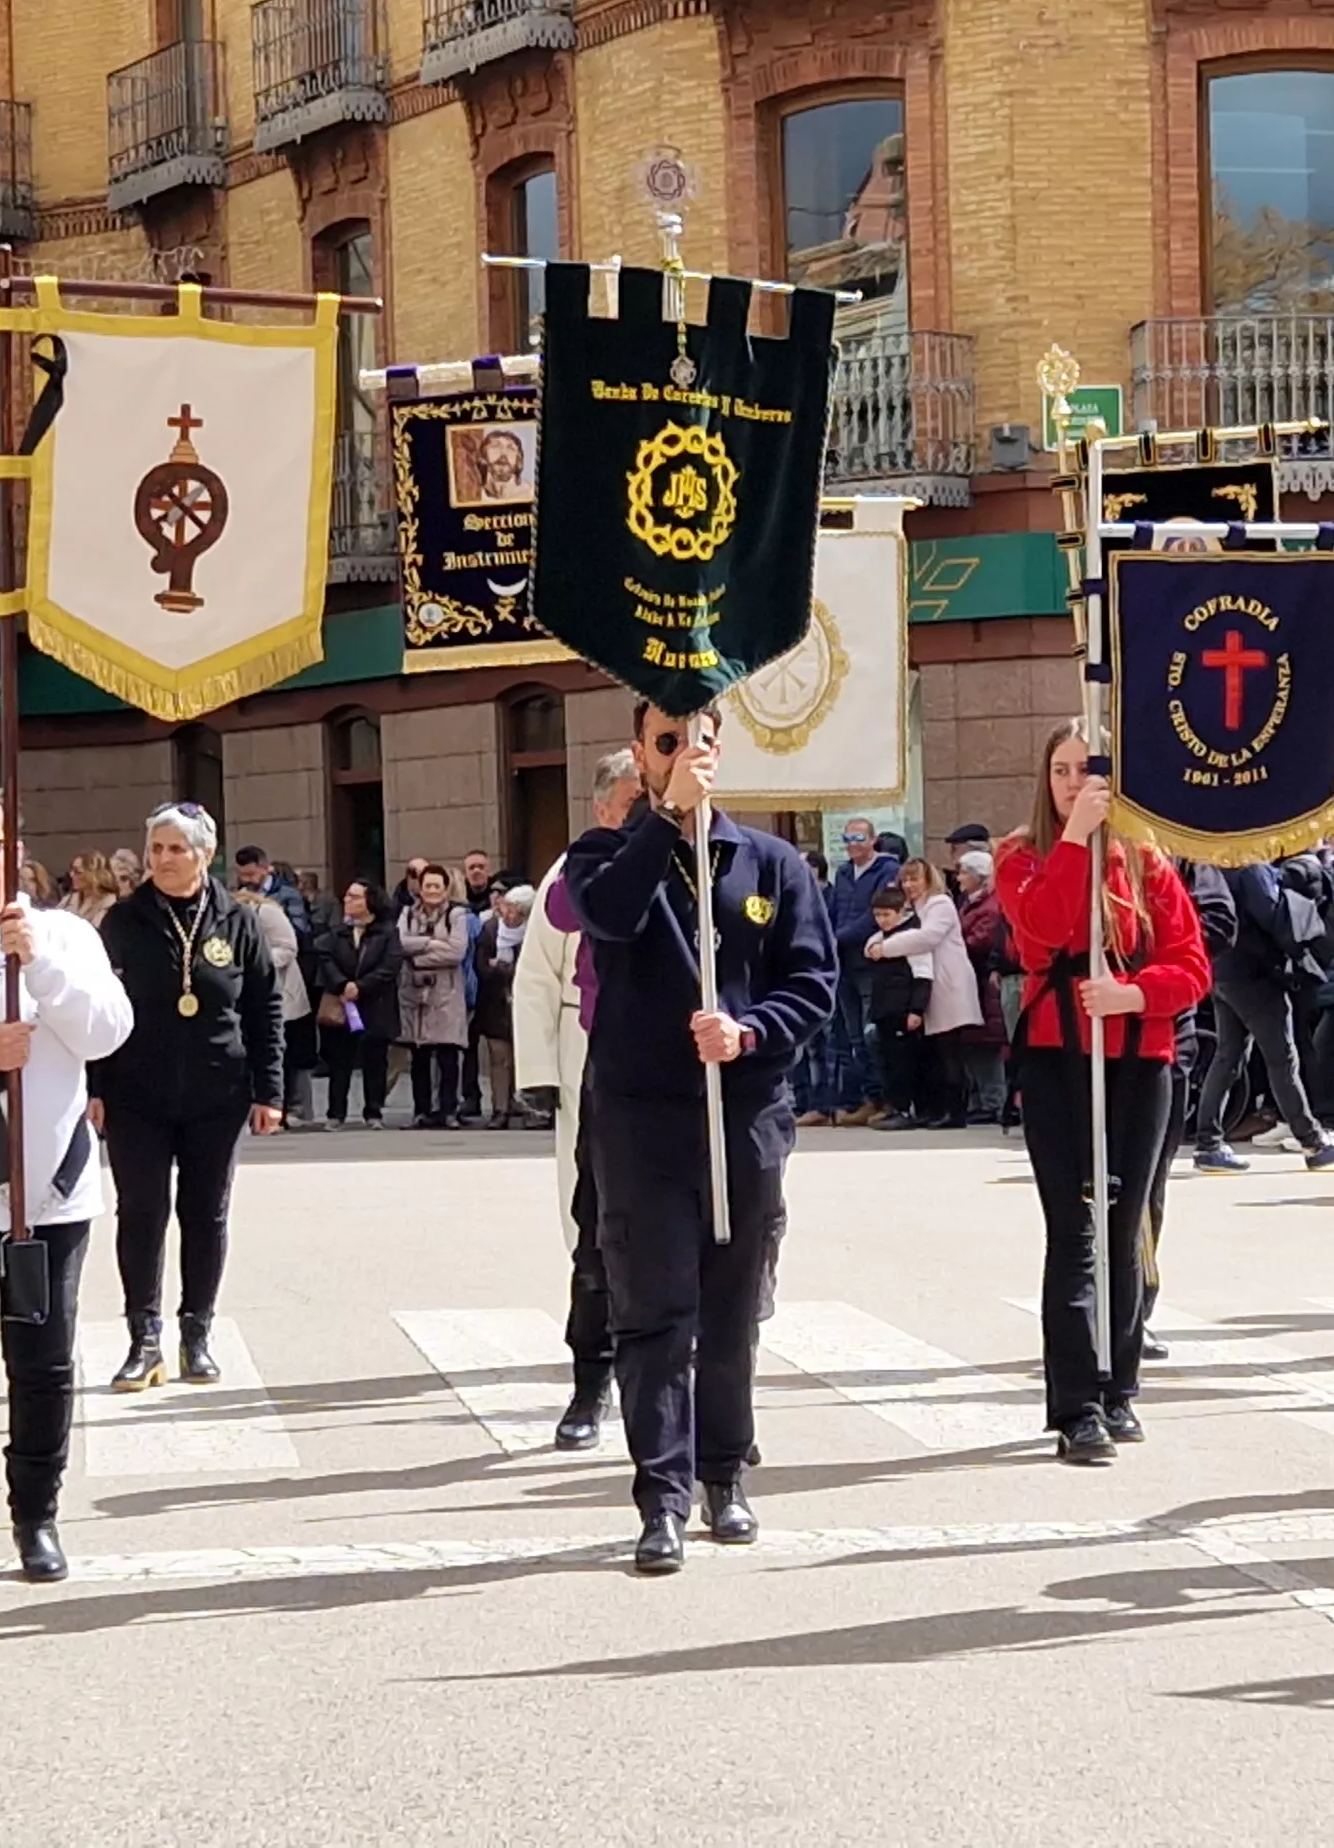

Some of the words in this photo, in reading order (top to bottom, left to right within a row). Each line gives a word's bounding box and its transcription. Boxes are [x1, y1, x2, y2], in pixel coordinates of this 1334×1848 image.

[1168, 699, 1208, 758] CRISTO
[1207, 750, 1229, 768] DE
[1231, 747, 1253, 767] LA
[1251, 652, 1292, 753] ESPERANZA
